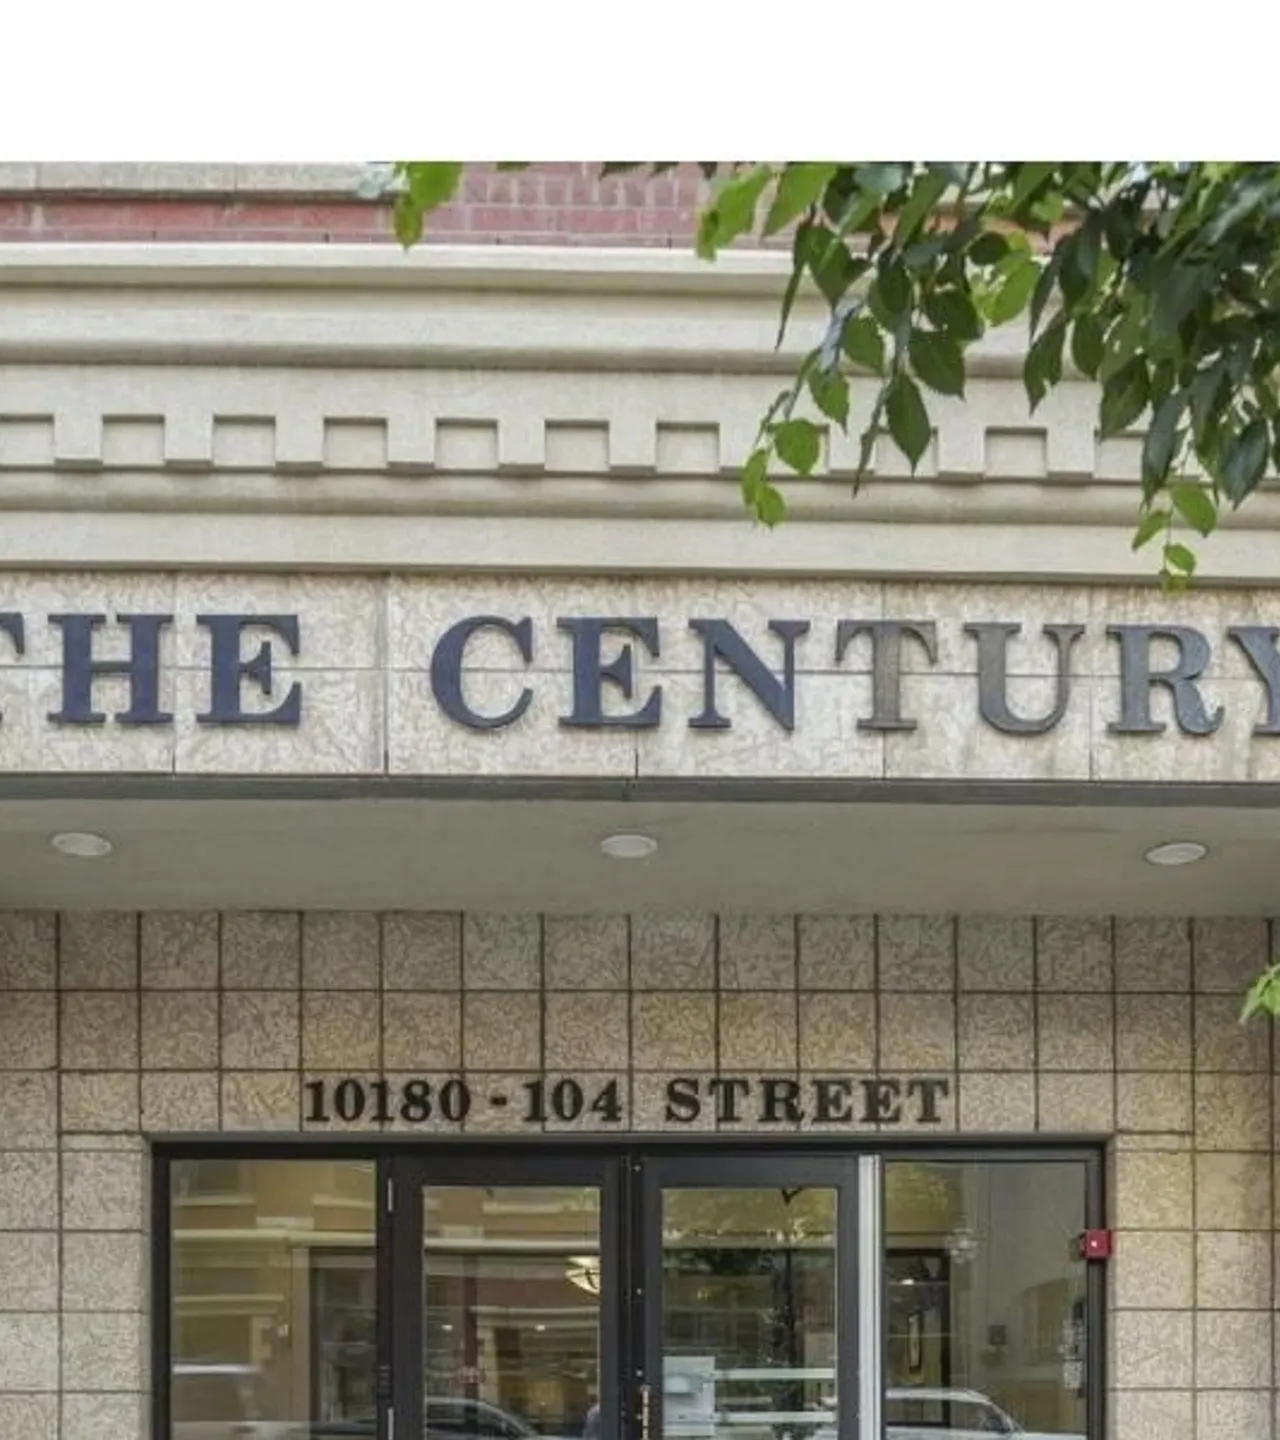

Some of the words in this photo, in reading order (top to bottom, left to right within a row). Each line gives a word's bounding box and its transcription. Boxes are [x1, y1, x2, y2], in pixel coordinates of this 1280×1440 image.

[305, 1079, 471, 1123] 10180
[521, 1079, 623, 1123] 104
[665, 1077, 949, 1124] STREET
